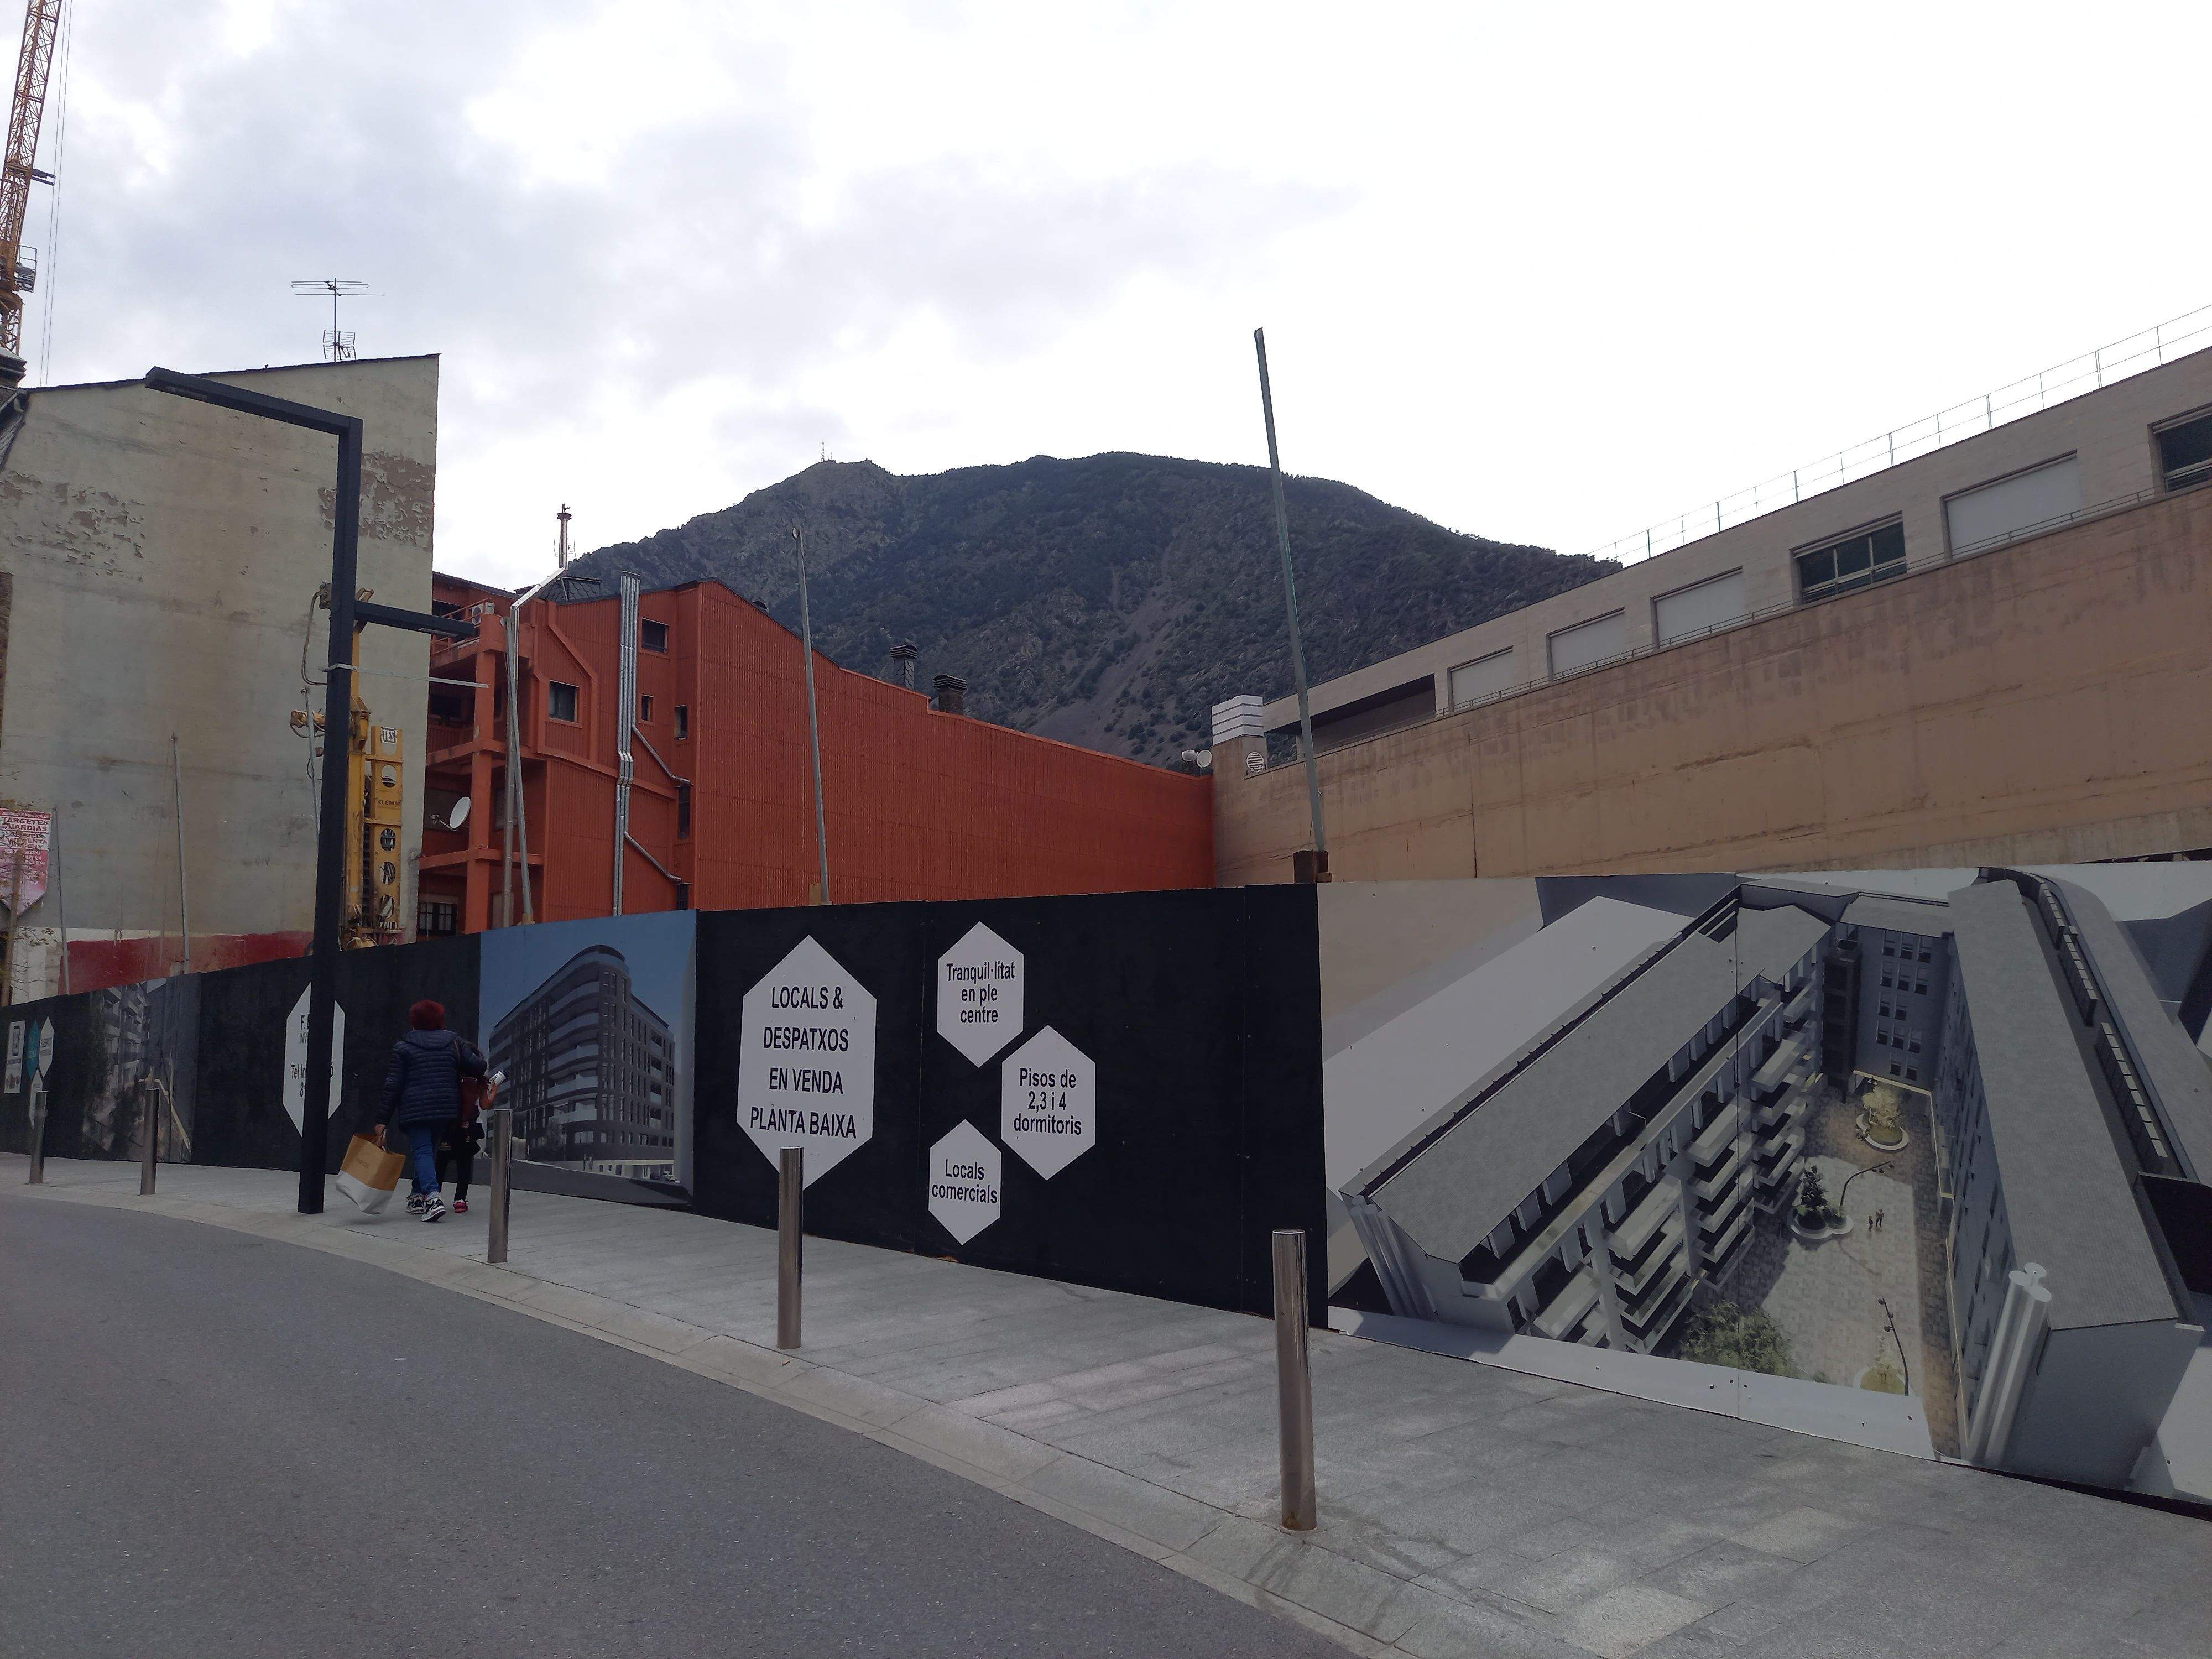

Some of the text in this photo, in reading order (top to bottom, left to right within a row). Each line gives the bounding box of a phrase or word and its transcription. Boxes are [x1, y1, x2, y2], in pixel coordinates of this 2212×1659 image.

[3, 817, 49, 826] TARGETES
[946, 961, 1015, 984] Tranquil·litat
[771, 986, 843, 1010] LOCALS &
[961, 983, 998, 1006] en ple
[961, 1006, 998, 1023] centre
[763, 1026, 849, 1052] DESPATXOS
[769, 1067, 843, 1094] EN VENDA
[1020, 1068, 1076, 1088] Pisos de
[1028, 1091, 1067, 1113] 2,3 i 4
[750, 1107, 857, 1139] PLANTA BAIXA
[1014, 1113, 1082, 1135] dormitoris
[945, 1159, 984, 1180] Locals
[932, 1183, 998, 1204] comercials
